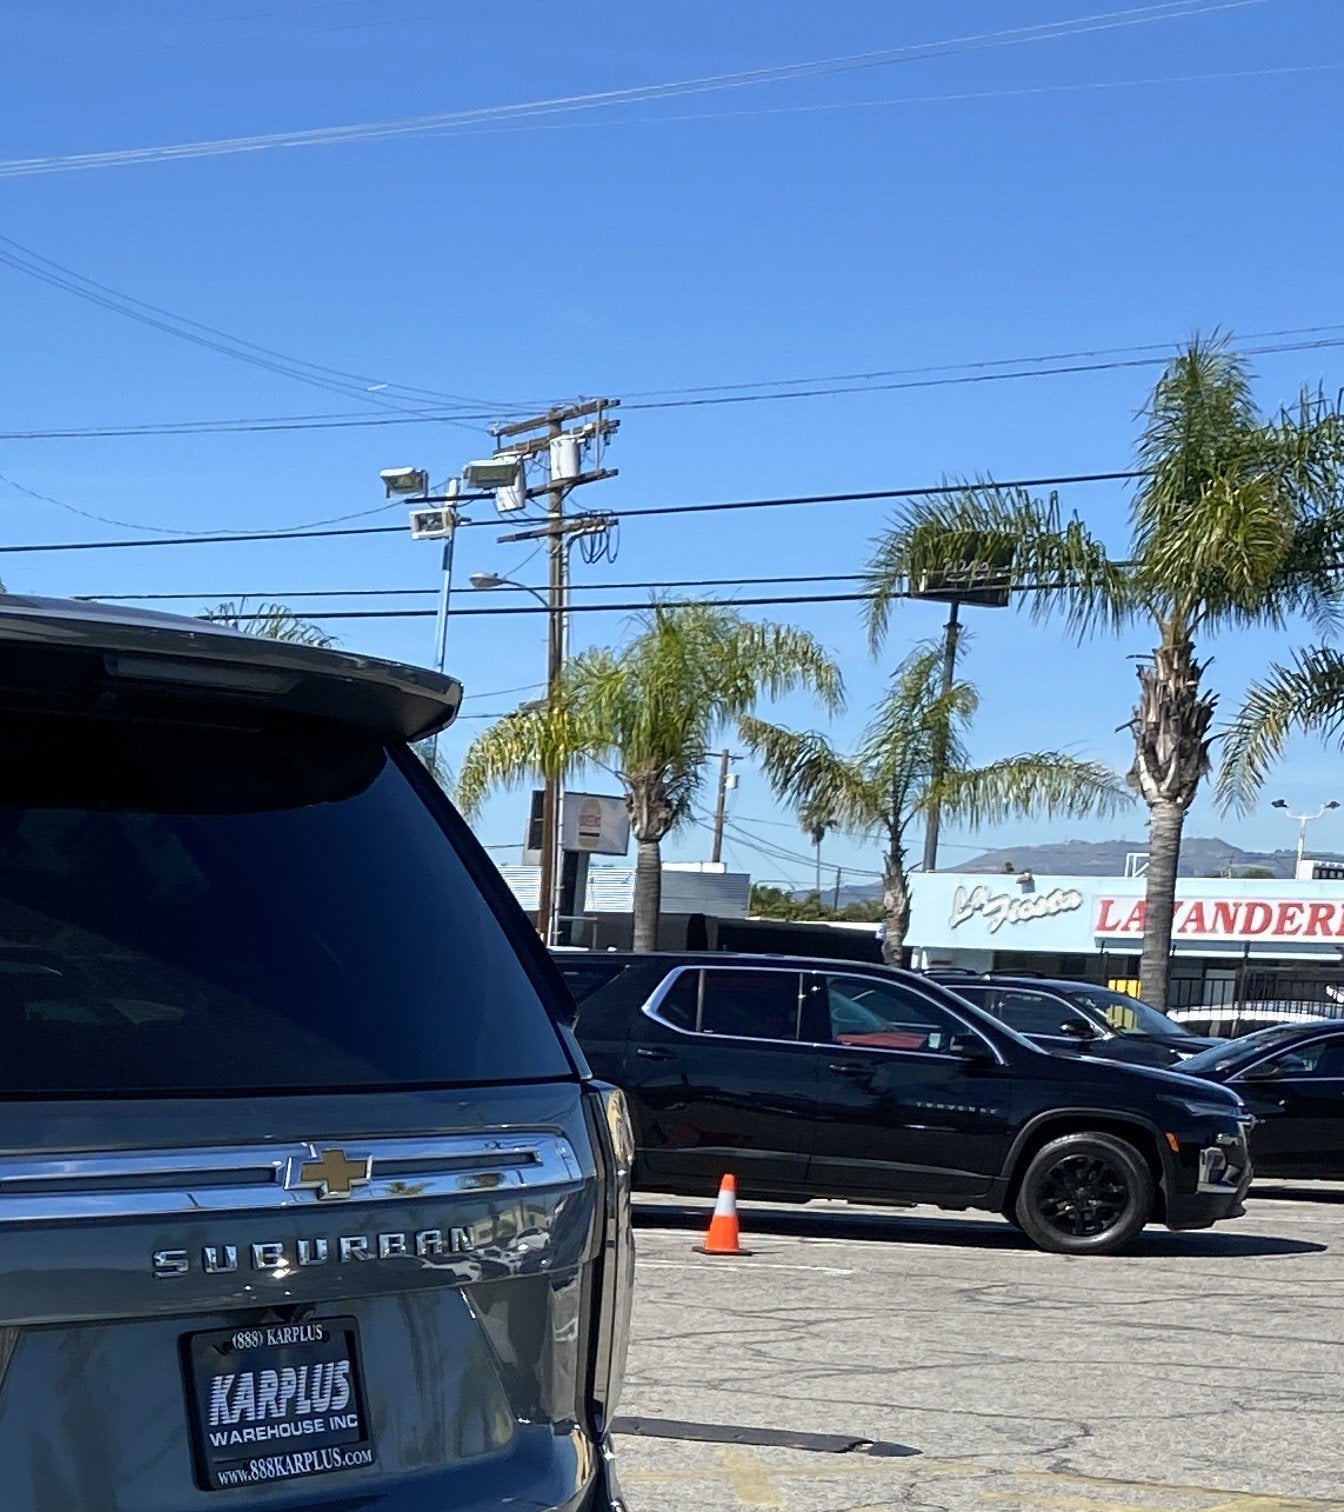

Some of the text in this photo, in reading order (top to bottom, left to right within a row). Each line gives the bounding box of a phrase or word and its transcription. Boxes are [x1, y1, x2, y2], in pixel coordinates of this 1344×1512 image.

[152, 1226, 475, 1278] SUBURBAN
[232, 1324, 323, 1349] (888) KARPLUS
[209, 1359, 350, 1426] KARPLUS
[209, 1413, 358, 1447] WAREHOUSE INC
